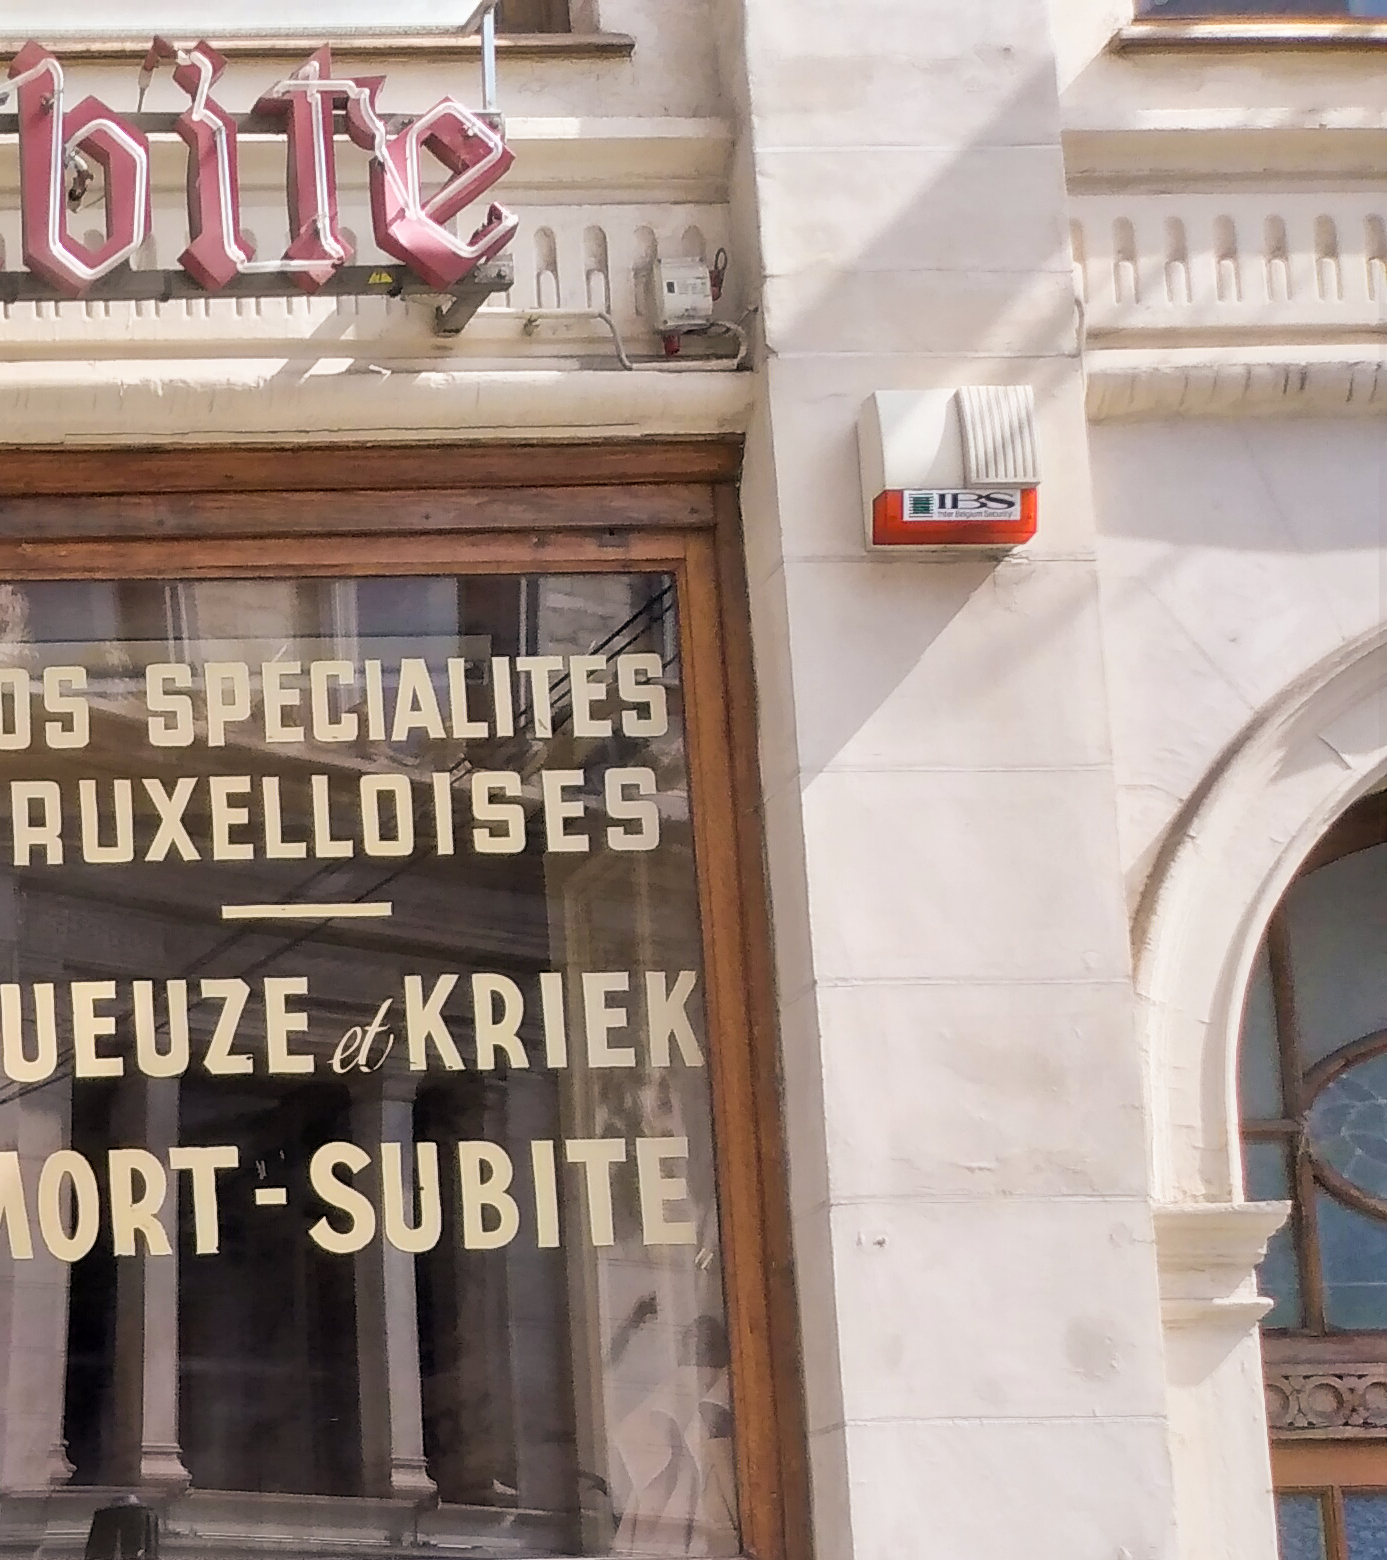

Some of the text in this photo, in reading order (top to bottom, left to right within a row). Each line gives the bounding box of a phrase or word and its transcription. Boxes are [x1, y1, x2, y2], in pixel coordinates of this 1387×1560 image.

[938, 491, 1015, 510] IBS
[938, 510, 1013, 519] Inter Belgium Security
[145, 640, 670, 748] SPÉCIALITÉS
[328, 998, 394, 1075] et
[403, 971, 706, 1074] KRIEK
